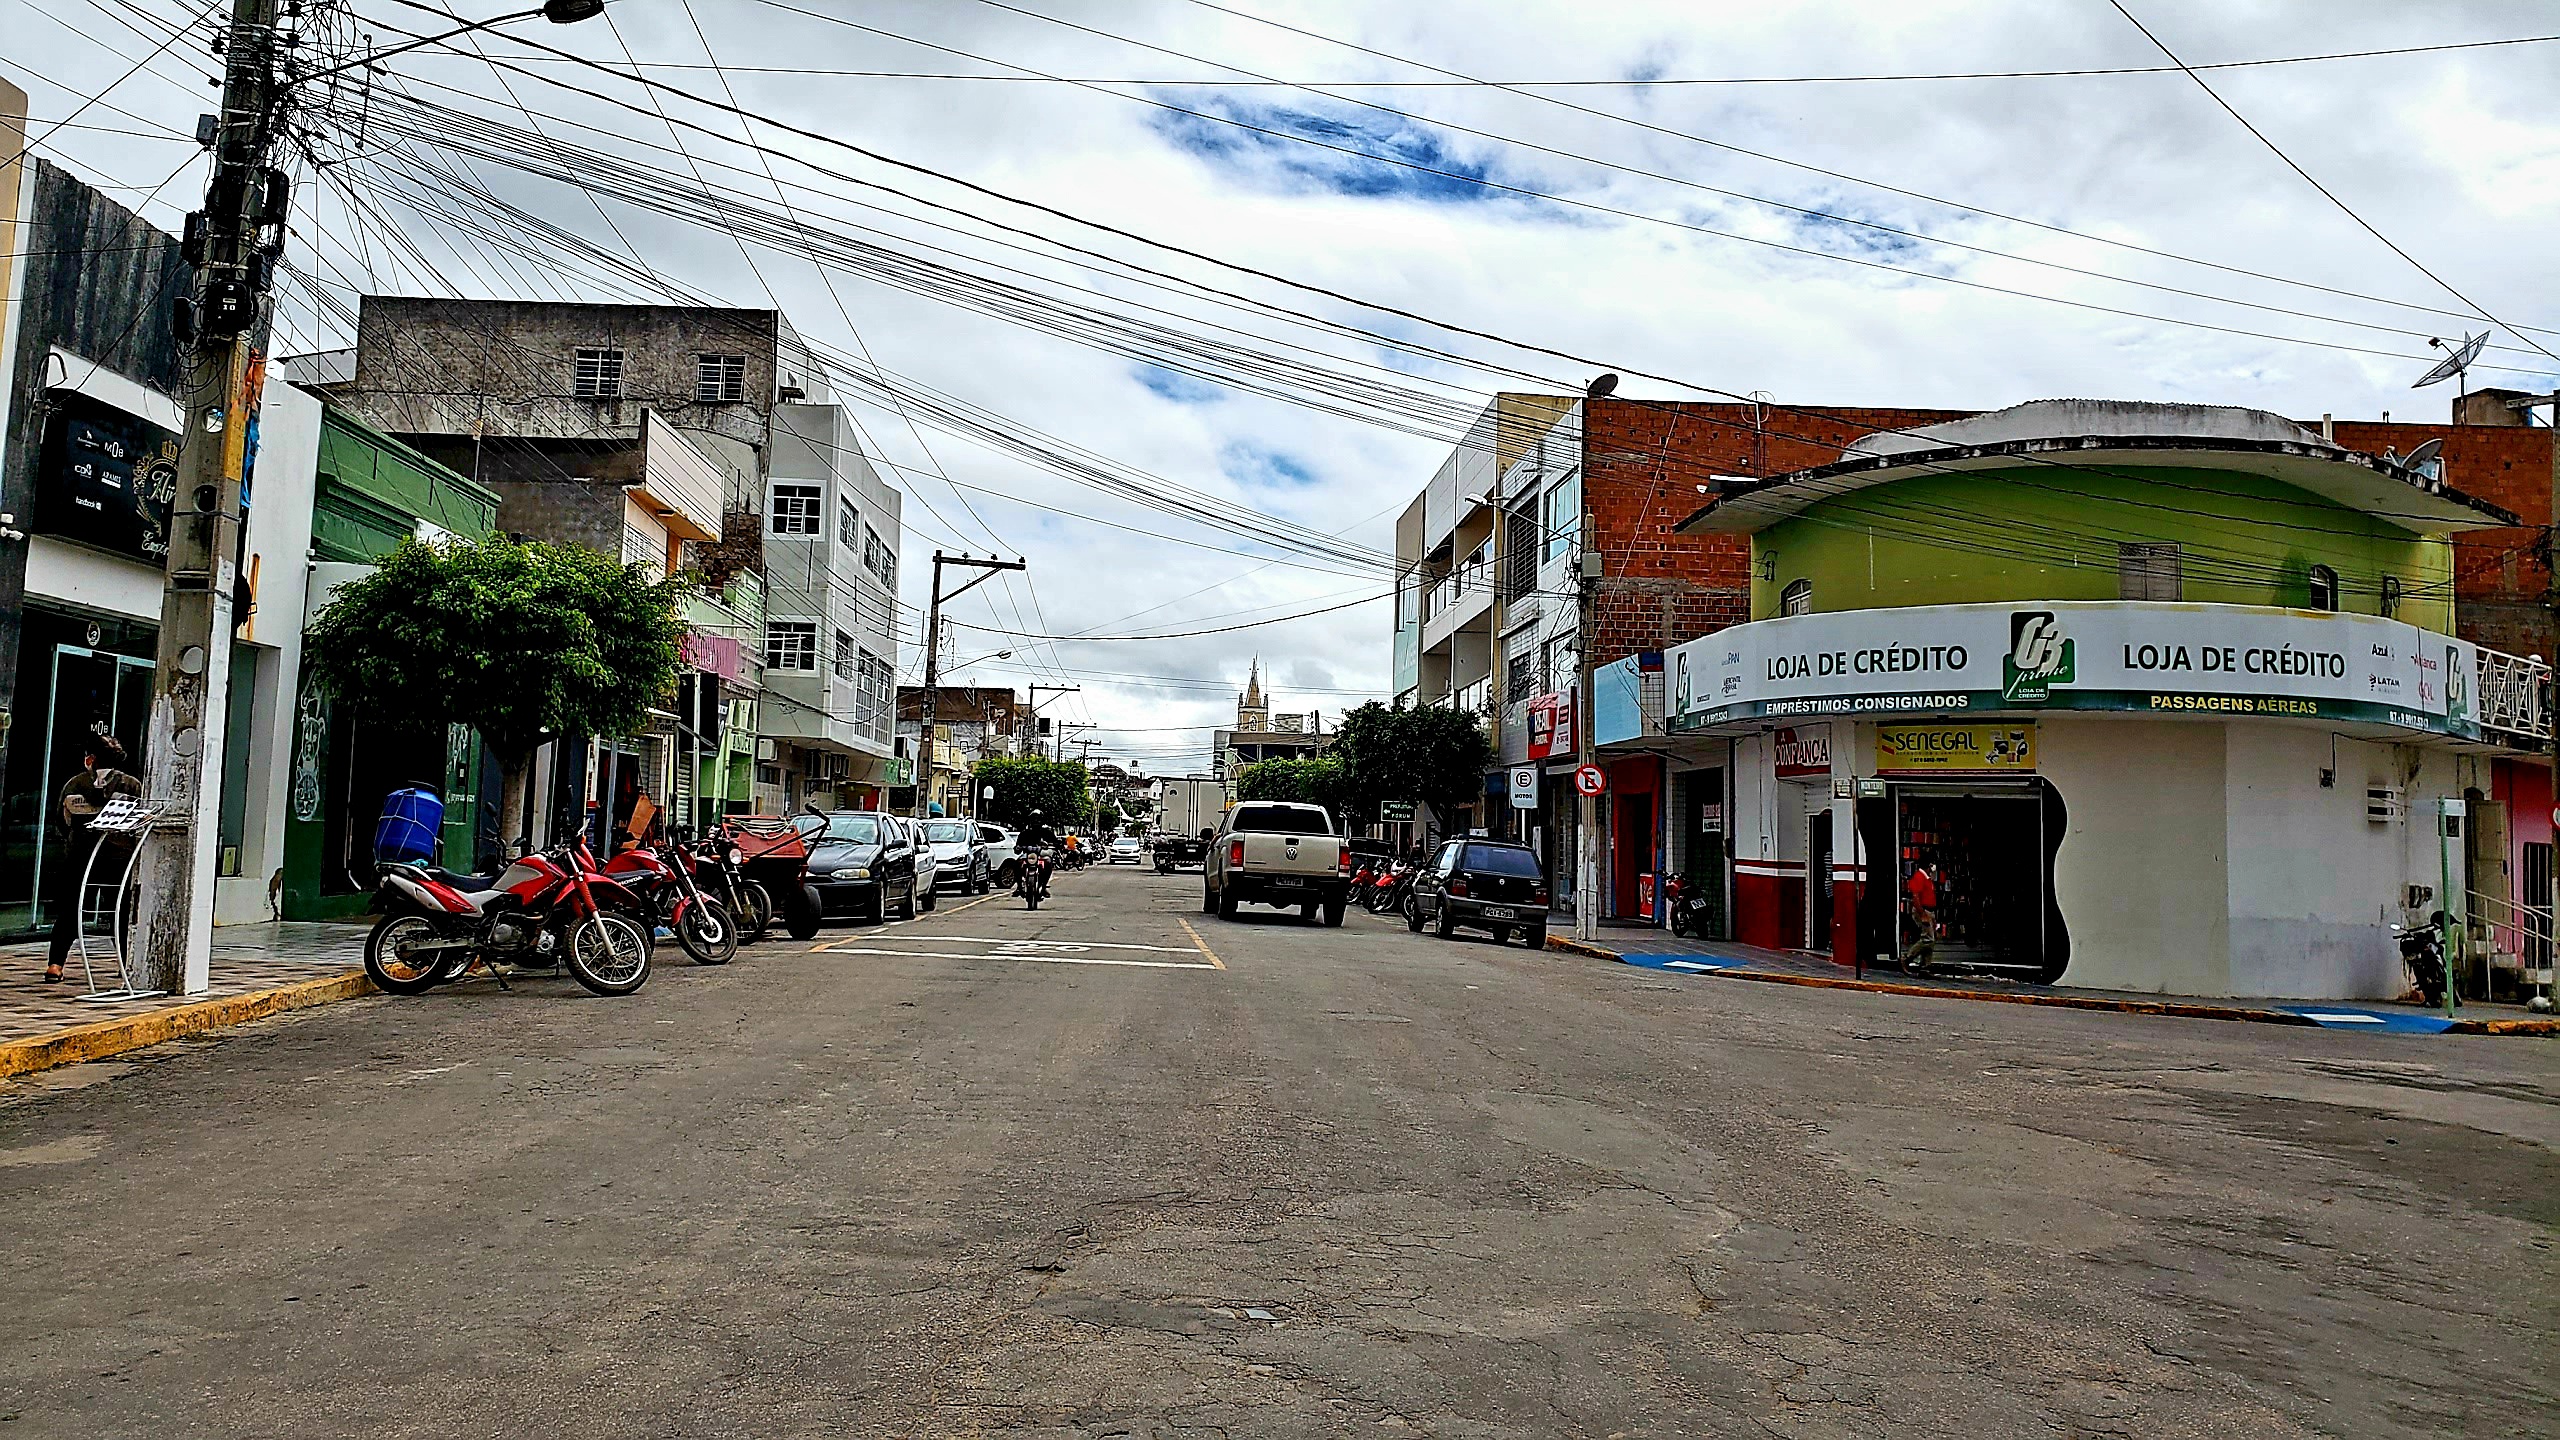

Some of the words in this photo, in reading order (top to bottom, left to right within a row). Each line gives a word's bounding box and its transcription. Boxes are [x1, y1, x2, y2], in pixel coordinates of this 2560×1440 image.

[104, 441, 124, 458] MOB
[2123, 644, 2192, 671] LOJA
[2202, 646, 2236, 672] DE
[2244, 642, 2345, 678] CRÉDITO
[2371, 643, 2388, 657] Azul
[1767, 654, 1811, 681] LOJA
[1818, 652, 1847, 675] DE
[1853, 641, 1968, 674] CRÉDITO
[2378, 676, 2400, 687] LATAM
[1766, 698, 1850, 715] EMPRÉSTIMOS
[1854, 695, 1968, 711] CONSIGNADOS
[2151, 695, 2254, 712] PASSAGENS
[2257, 697, 2318, 715] AÉREAS
[90, 720, 109, 736] MOB
[1895, 731, 1979, 751] SENEGAL
[1774, 739, 1830, 766] CONFIANÇA
[618, 876, 643, 885] HONDA
